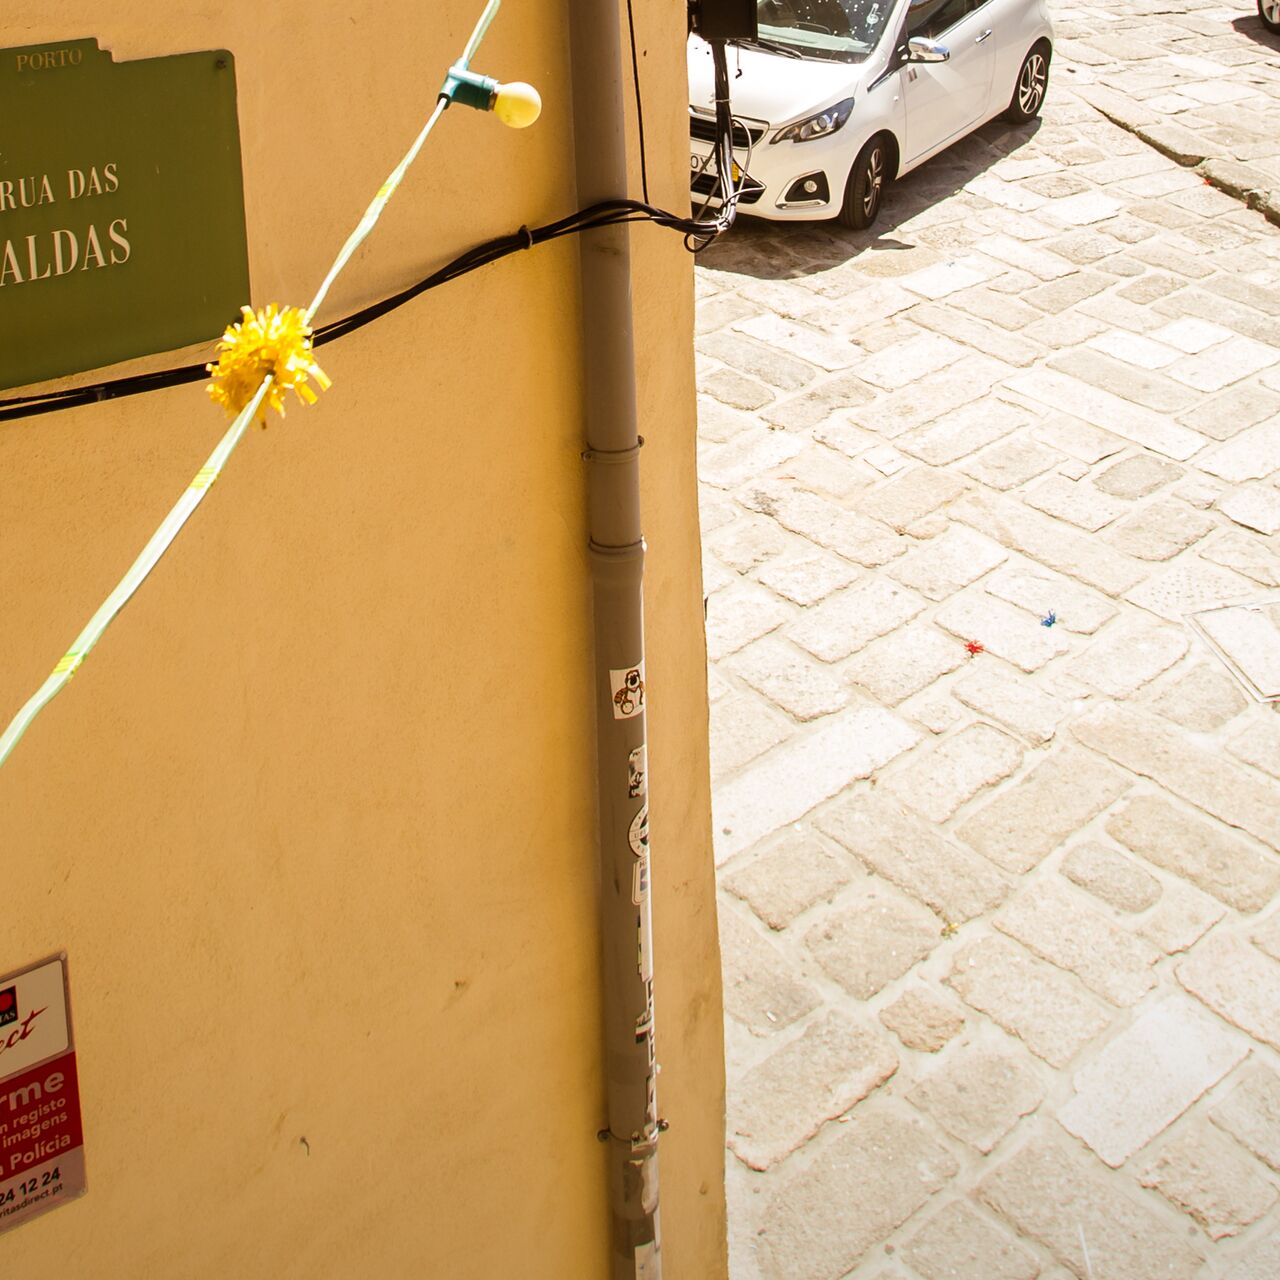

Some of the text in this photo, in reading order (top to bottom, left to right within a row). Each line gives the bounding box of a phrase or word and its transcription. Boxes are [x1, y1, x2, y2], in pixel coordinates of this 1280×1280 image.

[16, 48, 83, 73] PORTO
[68, 162, 120, 199] DAS
[3, 1111, 68, 1148] imagens
[13, 1098, 66, 1128] registo
[10, 1133, 71, 1170] Polícia
[20, 1178, 39, 1196] 12
[42, 1166, 61, 1186] 24
